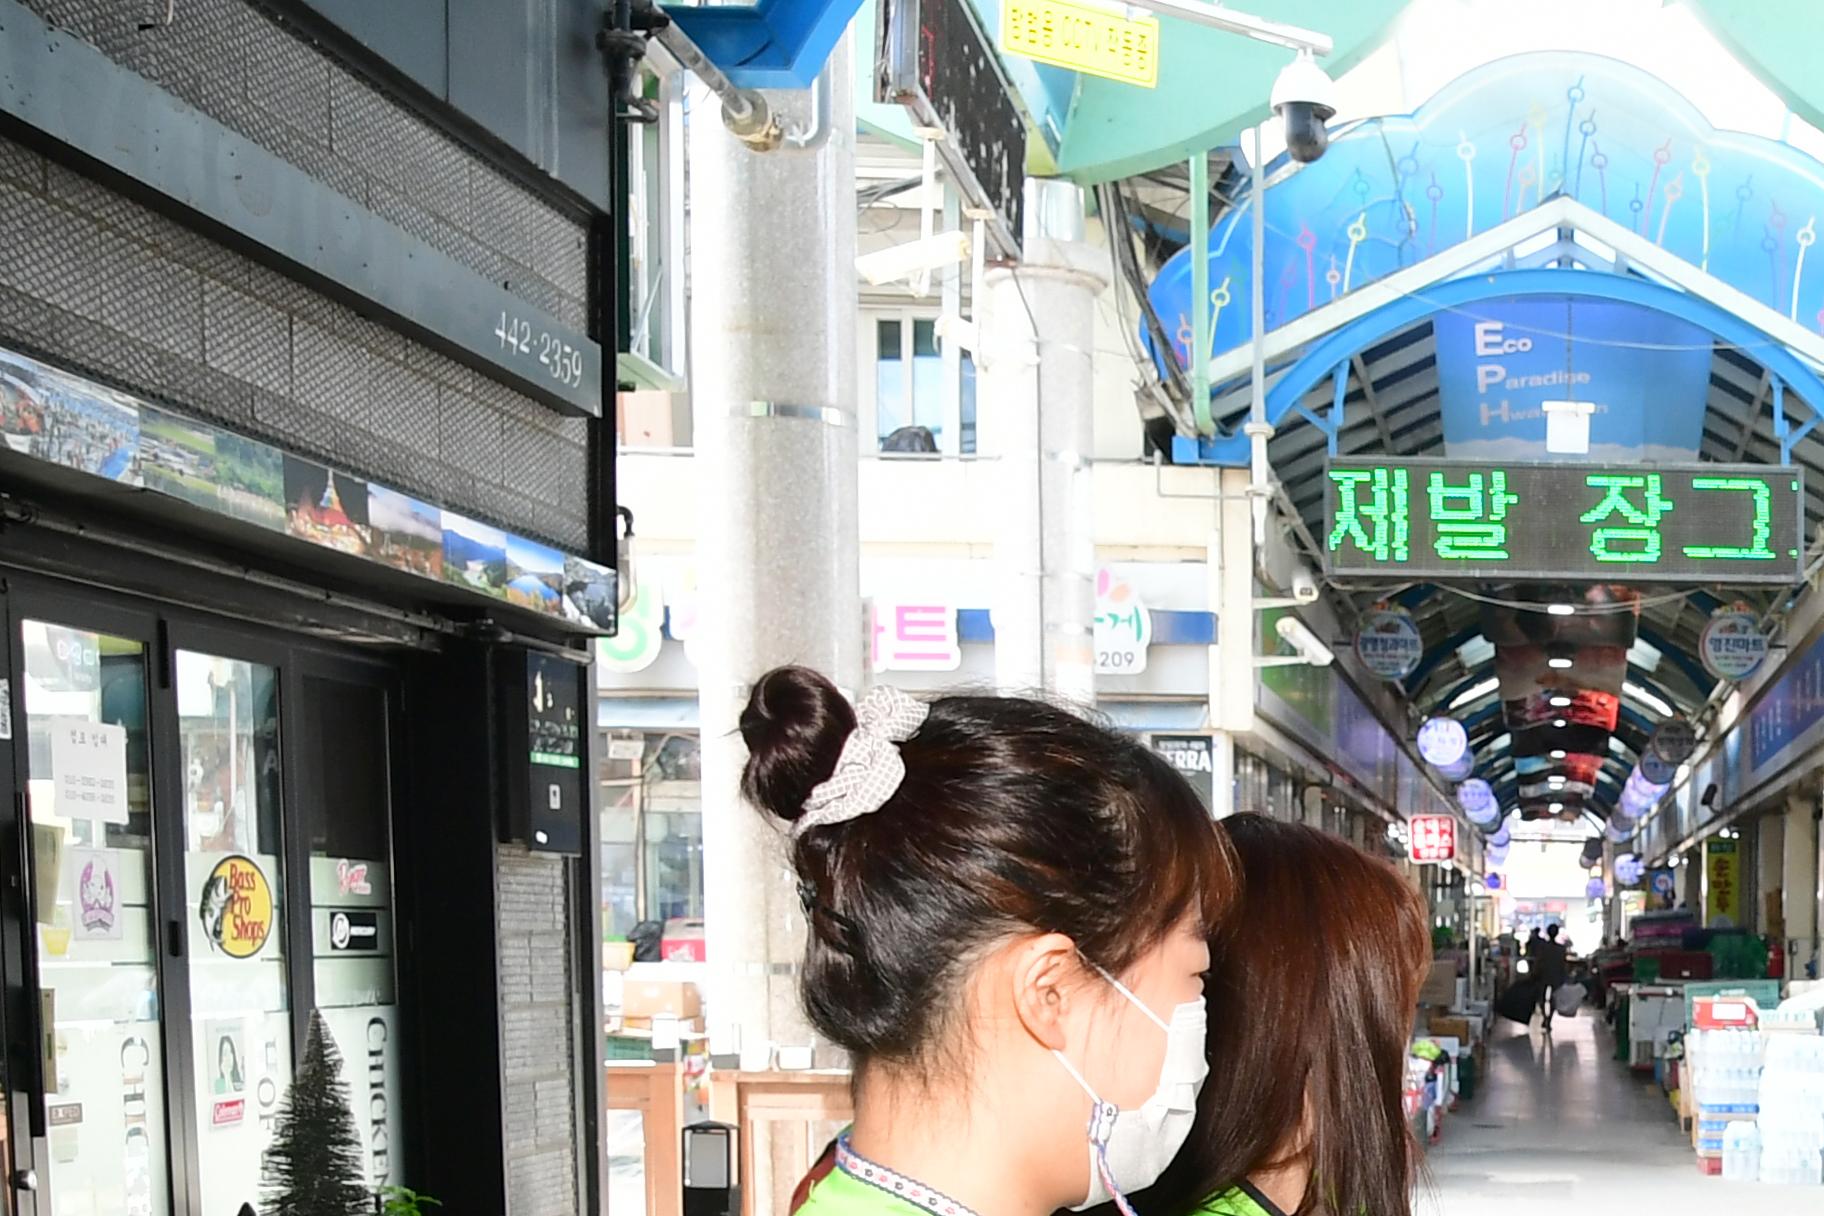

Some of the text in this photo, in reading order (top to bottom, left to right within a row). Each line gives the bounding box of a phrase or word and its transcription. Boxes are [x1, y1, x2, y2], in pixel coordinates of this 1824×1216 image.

[1474, 321, 1534, 358] Eco
[1476, 362, 1592, 395] Paradise
[1327, 466, 1799, 564] 제발 잠그
[870, 605, 952, 662] 트
[1165, 749, 1213, 773] ERRA
[228, 862, 257, 892] Bass
[230, 892, 252, 916] Pro
[231, 915, 266, 947] Shops
